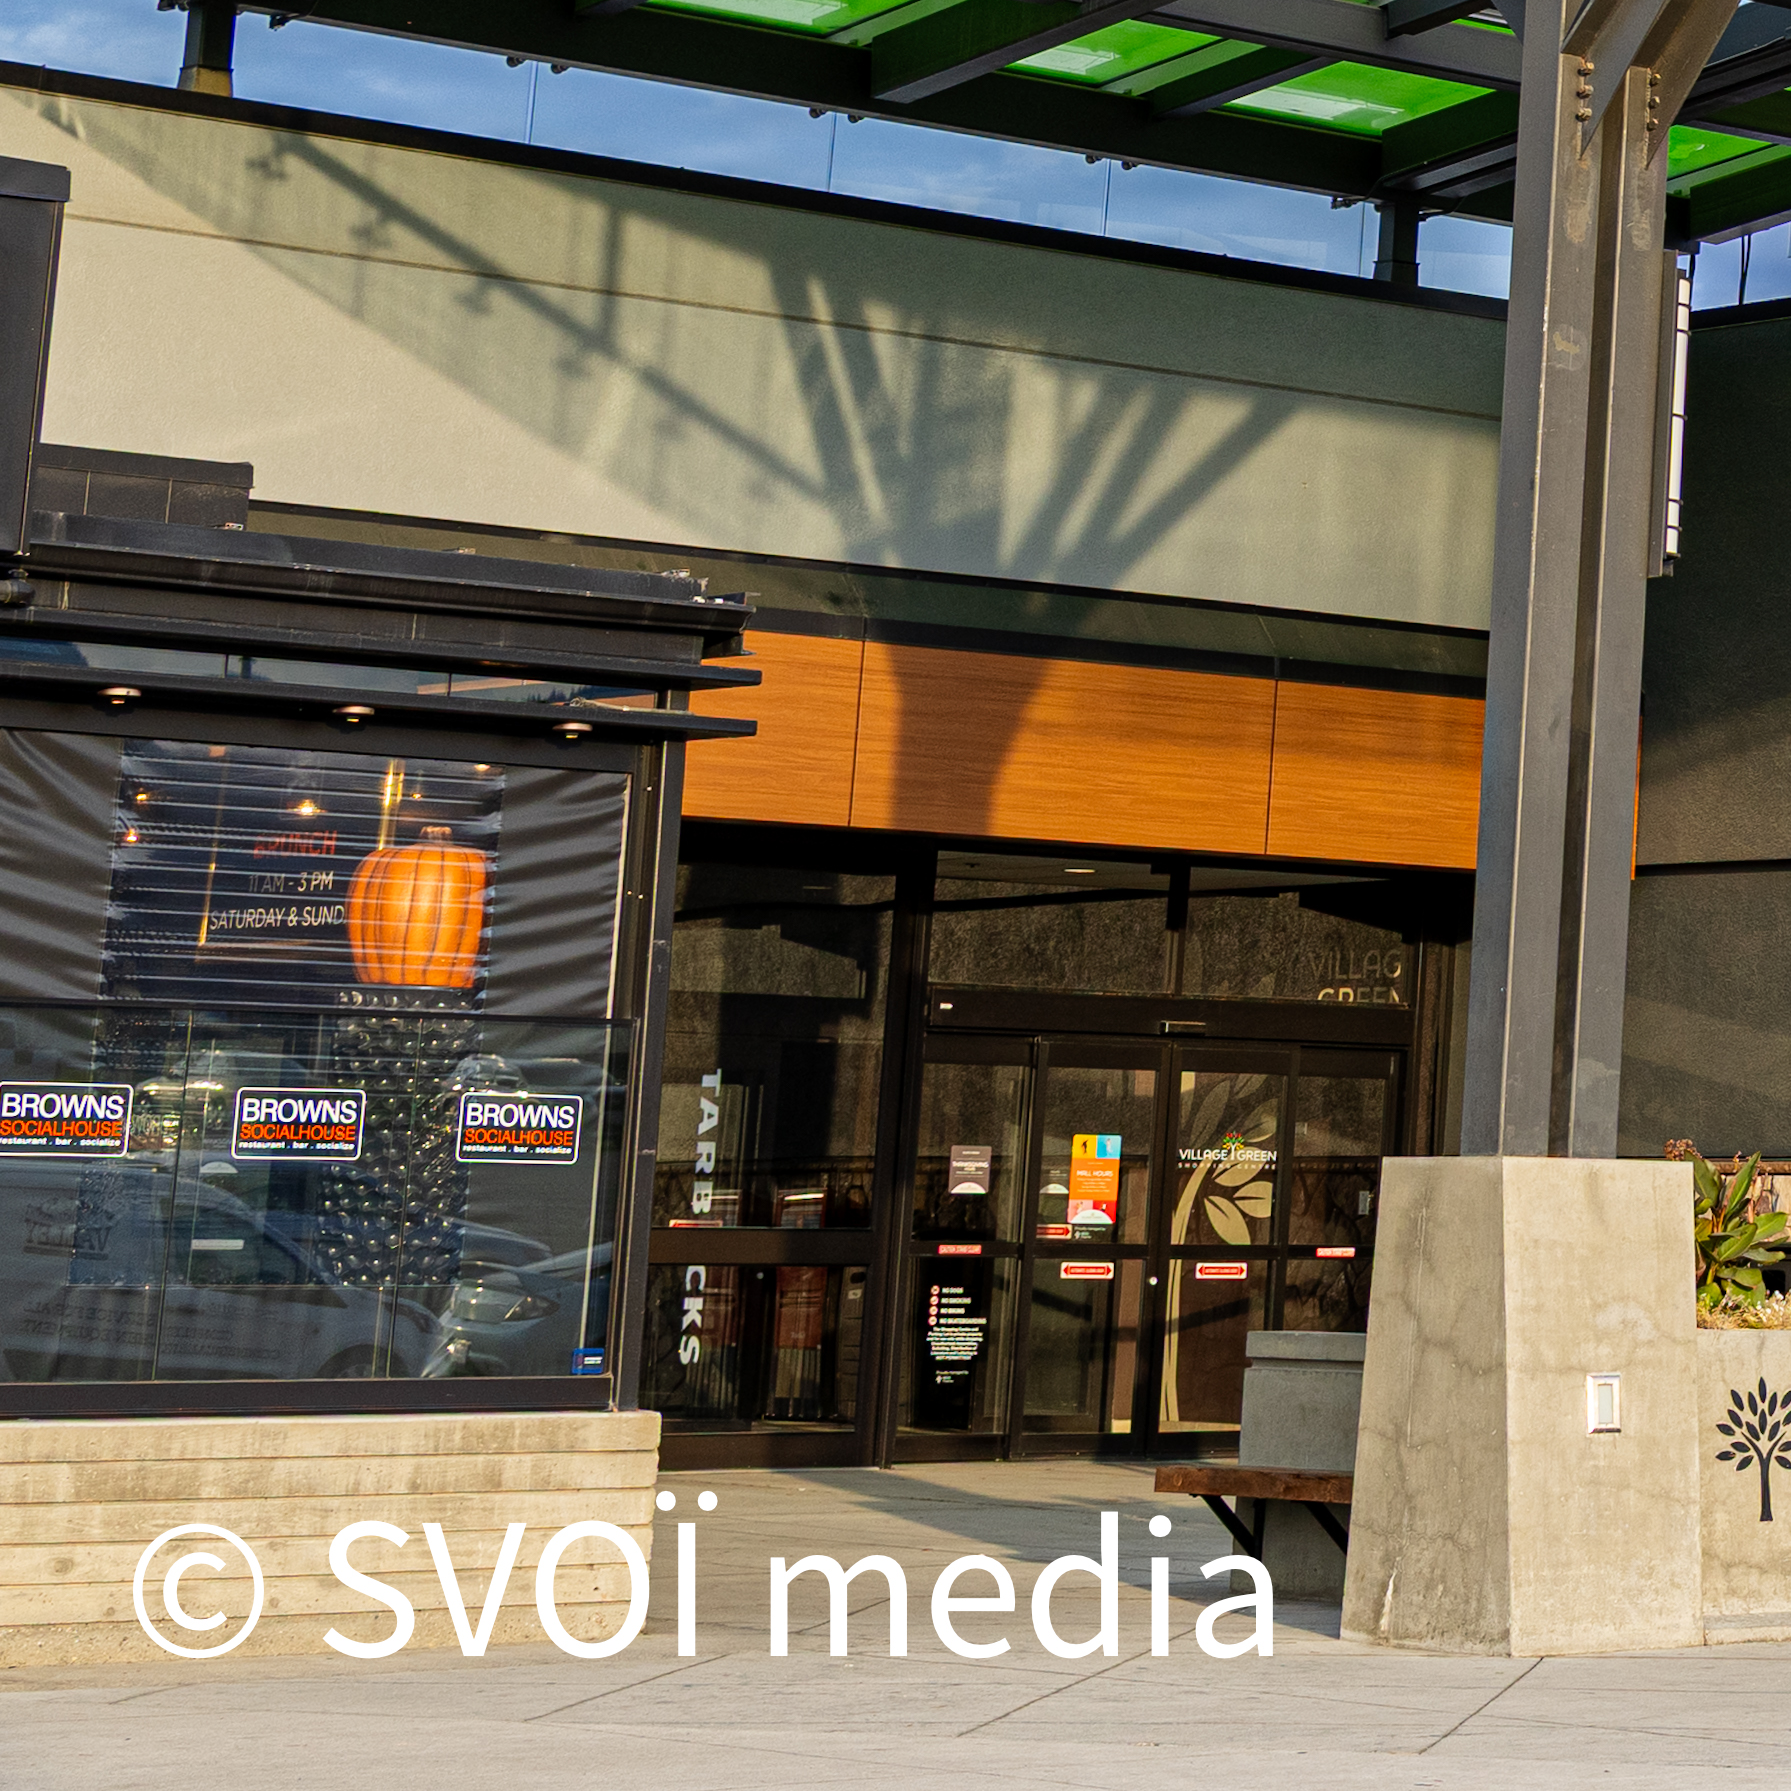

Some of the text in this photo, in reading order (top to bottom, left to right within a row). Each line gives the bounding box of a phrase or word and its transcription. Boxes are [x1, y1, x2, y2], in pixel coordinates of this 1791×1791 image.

[261, 872, 285, 893] AM
[297, 871, 307, 892] 3
[310, 870, 335, 892] PM
[209, 904, 347, 931] SATURDAY & SUND
[1, 1093, 125, 1120] BROWNS
[241, 1097, 358, 1124] BROWNS
[465, 1102, 575, 1129] BROWNS
[0, 1119, 123, 1138] SOCIALHOUSE
[240, 1123, 356, 1141] SOCIALHOUSE
[464, 1127, 575, 1146] SOCIALHOUSE
[55, 1137, 73, 1146] bar
[79, 1138, 122, 1147] socialize
[238, 1140, 355, 1150] restaurant bar socialize
[513, 1145, 529, 1153] bar
[534, 1145, 573, 1154] socialize
[1178, 1148, 1278, 1162] VILLAGE GREEN
